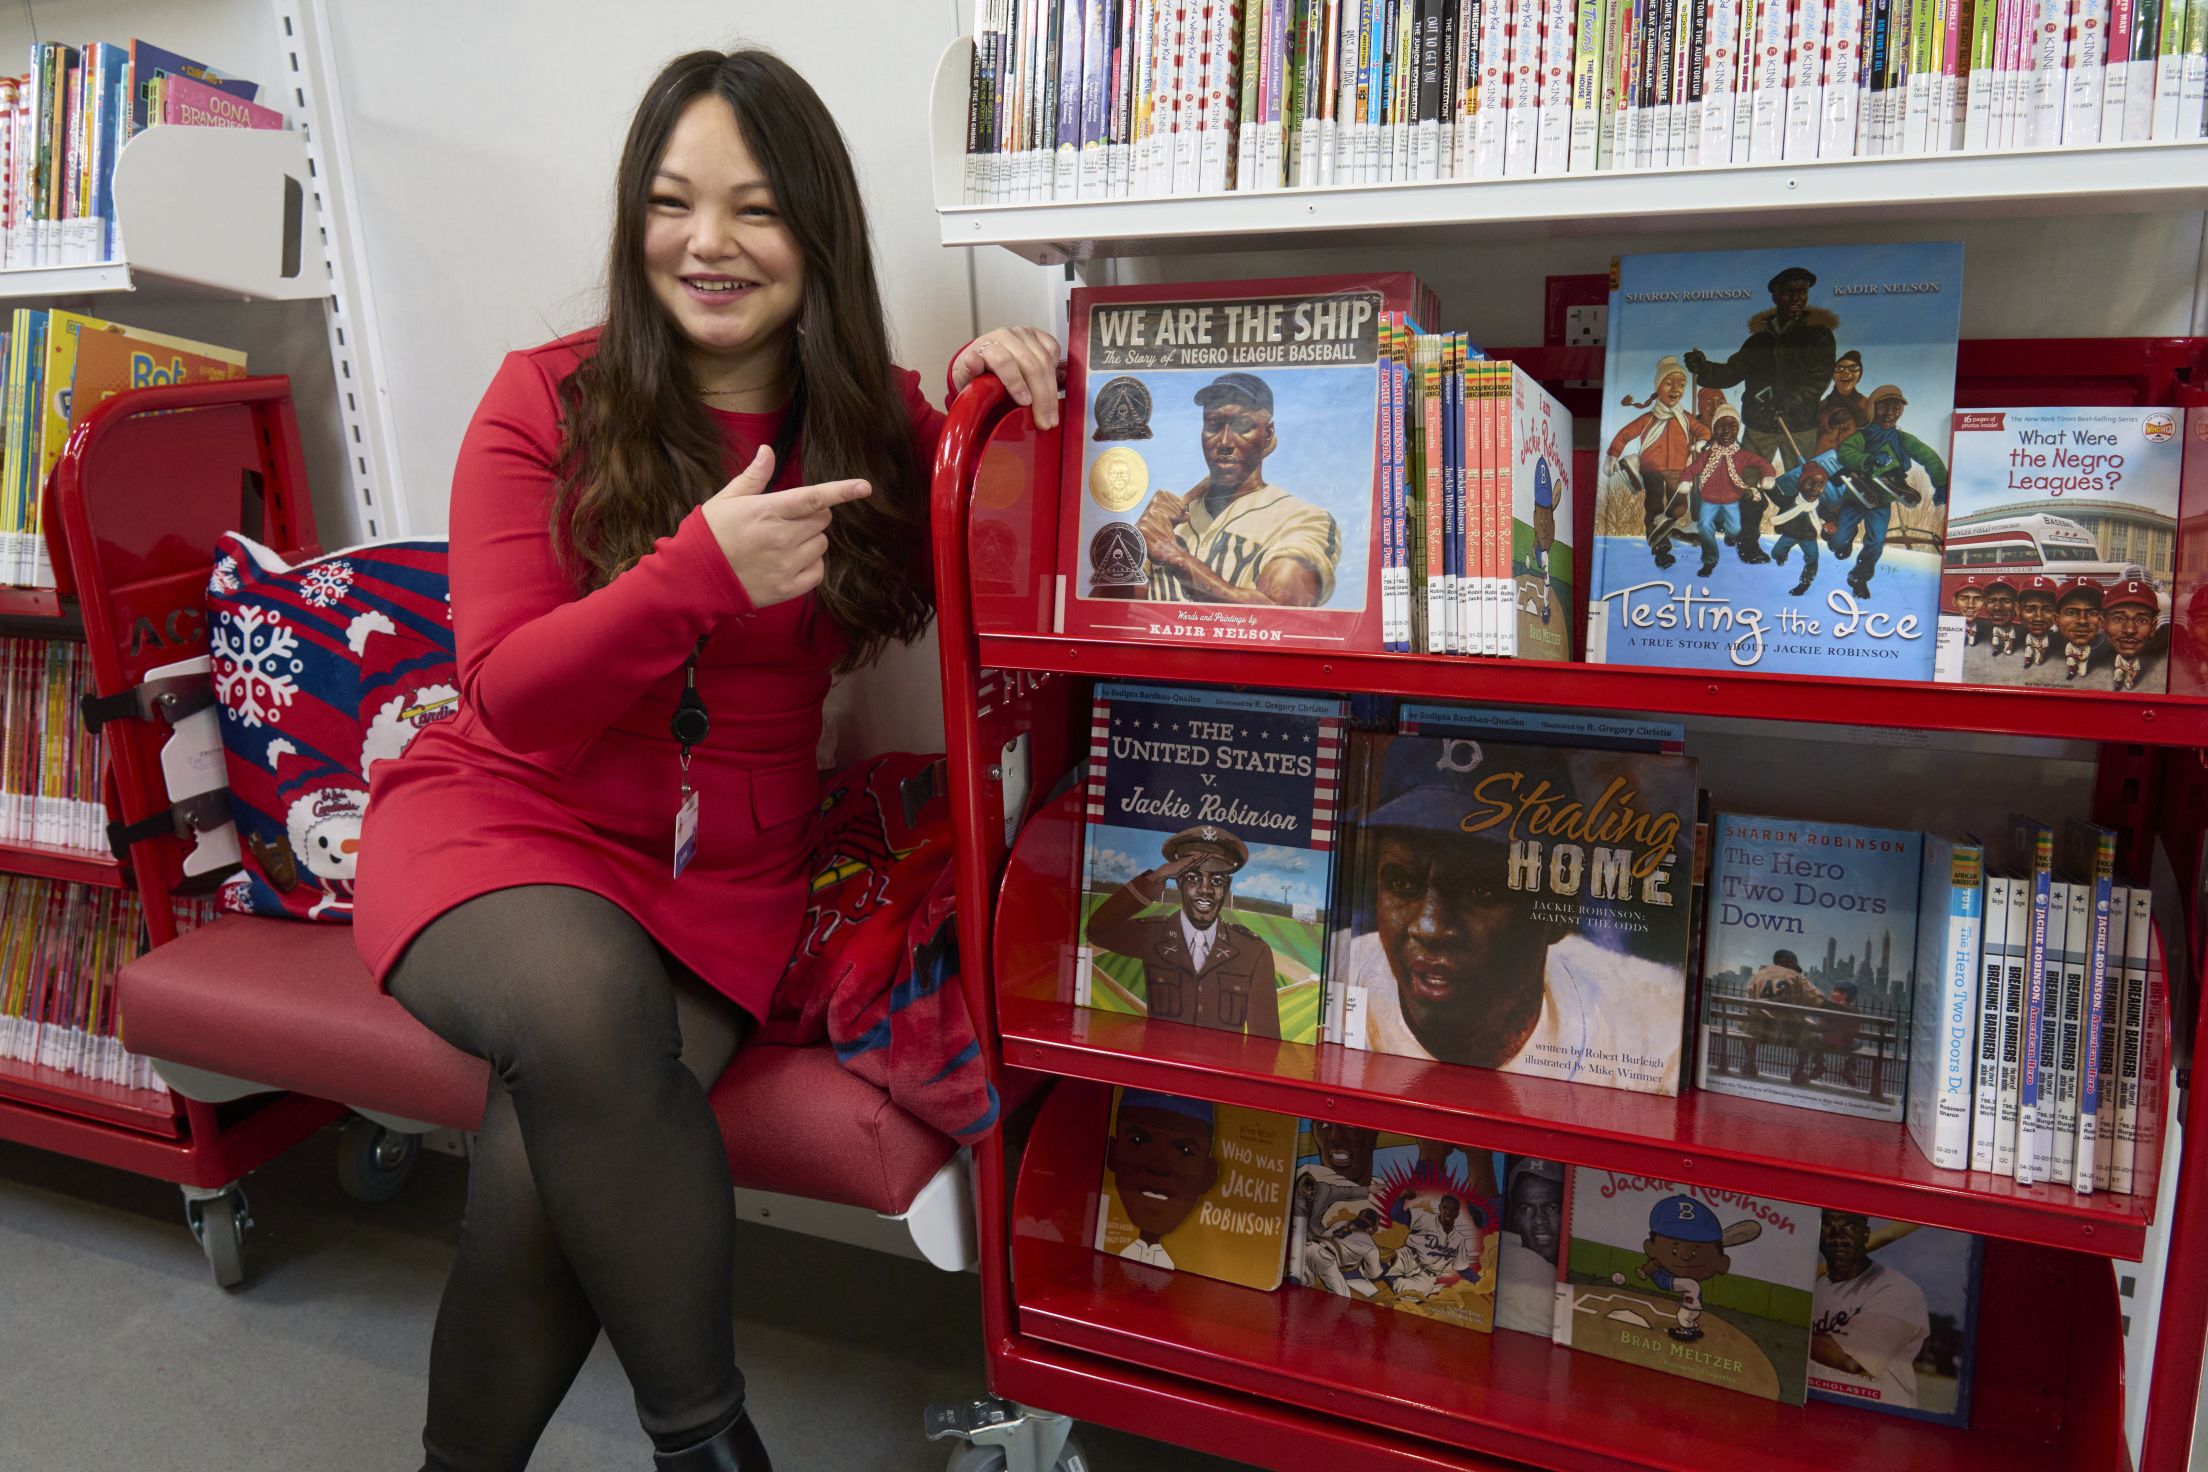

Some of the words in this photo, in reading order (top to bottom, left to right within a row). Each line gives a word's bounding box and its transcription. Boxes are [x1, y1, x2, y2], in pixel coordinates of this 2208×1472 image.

[1162, 23, 1171, 47] Wimpy
[1427, 16, 1438, 33] OUT
[1583, 9, 1597, 52] Twins
[1664, 20, 1671, 30] TO
[1697, 19, 1704, 28] OF
[2119, 14, 2127, 34] MASK
[1343, 30, 1355, 45] ONLY
[1412, 37, 1420, 64] JUNIOR
[1426, 38, 1437, 47] TO
[1662, 32, 1670, 53] CAMP
[1162, 48, 1170, 60] Kid
[1245, 28, 1257, 90] RIDERS
[1425, 50, 1437, 66] GET
[1343, 70, 1355, 88] DARE
[1424, 71, 1436, 83] YOU
[1661, 55, 1670, 100] NIGHTMARE
[1692, 47, 1702, 96] AUDITORIUM
[1411, 66, 1419, 119] NOVELIZATION
[1442, 63, 1450, 119] NOVELIZATION
[210, 97, 252, 124] OONA
[1625, 291, 1679, 303] SHARON
[1682, 289, 1751, 301] ROBINSON
[1834, 283, 1878, 296] KADIR
[1883, 282, 1940, 294] NELSON
[1099, 310, 1147, 347] WE
[1154, 306, 1212, 345] ARE
[1224, 304, 1283, 343] THE
[1294, 301, 1372, 342] SHIP
[1103, 350, 1122, 364] The
[1125, 349, 1157, 367] Story
[1160, 348, 1174, 367] of
[1180, 348, 1227, 364] NEGRO
[1232, 346, 1284, 363] LEAGUE
[1289, 343, 1356, 362] BASEBALL
[2019, 430, 2067, 445] What
[2072, 430, 2118, 446] Were
[2009, 448, 2047, 468] the
[2052, 448, 2124, 475] Negro
[1445, 466, 1454, 493] Jackie
[2008, 471, 2122, 496] Leagues?
[1445, 495, 1454, 533] Robinson
[2034, 577, 2043, 587] C
[2078, 576, 2087, 586] C
[2128, 582, 2138, 593] C
[1150, 624, 1206, 637] KADIR
[1213, 627, 1283, 641] NELSON
[1602, 580, 1771, 666] Testing
[1775, 607, 1822, 636] the
[1827, 589, 1922, 639] Ice
[1627, 637, 1636, 647] A
[1640, 637, 1673, 649] TRUE
[1678, 639, 1719, 650] STORY
[1724, 642, 1768, 653] ABOUT
[1773, 644, 1822, 656] JACKIE
[1828, 647, 1899, 659] ROBINSON
[1189, 721, 1234, 742] THE
[1112, 736, 1210, 766] UNITED
[1216, 747, 1312, 777] STATES
[1200, 774, 1217, 787] v.
[1121, 786, 1192, 819] Jackie
[1197, 793, 1298, 831] Robinson
[1459, 771, 1682, 880] Stealing
[1725, 826, 1797, 844] SHARON
[1807, 833, 1905, 853] ROBINSON
[1507, 839, 1677, 907] HOME
[1725, 847, 1765, 866] The
[1771, 851, 1845, 880] Hero
[1722, 875, 1784, 902] Two
[1792, 882, 1887, 914] Doors
[1529, 911, 1581, 927] AGAINST
[1585, 917, 1611, 930] THE
[1614, 920, 1649, 934] ODDS
[1532, 900, 1574, 913] JACKIE
[1578, 905, 1647, 922] ROBINSON:
[1720, 903, 1804, 934] Down
[2035, 908, 2046, 941] JACKIE
[1959, 927, 1972, 948] The
[2098, 915, 2108, 947] JACKIE
[1953, 951, 1969, 987] Hero
[2031, 941, 2043, 1004] ROBINSON:
[2092, 948, 2105, 1011] ROBINSON:
[1985, 964, 2000, 1011] BREAKING
[2006, 966, 2021, 1013] BREAKING
[2064, 973, 2081, 1021] BREAKING
[1951, 991, 1968, 1021] Two
[2126, 979, 2143, 1027] BREAKING
[1982, 1013, 1998, 1060] BARRIERS
[2003, 1015, 2018, 1063] BARRIERS
[2028, 1007, 2039, 1057] American
[2089, 1014, 2100, 1067] American
[1535, 1042, 1569, 1055] written
[1571, 1045, 1584, 1057] by
[1585, 1047, 1618, 1061] Robert
[1621, 1051, 1664, 1069] Burleigh
[1949, 1025, 1966, 1073] Doors
[2062, 1023, 2078, 1071] BARRIERS
[2123, 1029, 2140, 1078] BARRIERS
[1524, 1054, 1571, 1071] illustrated
[1573, 1059, 1586, 1072] by
[1588, 1062, 1615, 1077] Mike
[1617, 1067, 1664, 1084] Wimmer
[2026, 1059, 2035, 1085] Hero
[2087, 1068, 2096, 1094] Hero
[1939, 1104, 1966, 1113] Robinson
[1939, 1110, 1960, 1118] Sharon
[1222, 1139, 1252, 1164] WHO
[1256, 1155, 1284, 1172] WAS
[1529, 1160, 1544, 1170] M
[1221, 1169, 1280, 1204] JACKIE
[1200, 1200, 1282, 1236] ROBINSON?
[1678, 1202, 1695, 1220] B
[1620, 1330, 1661, 1351] BRAD
[1670, 1343, 1743, 1374] MELTZER
[1808, 1377, 1879, 1398] SCHOLASTIC
